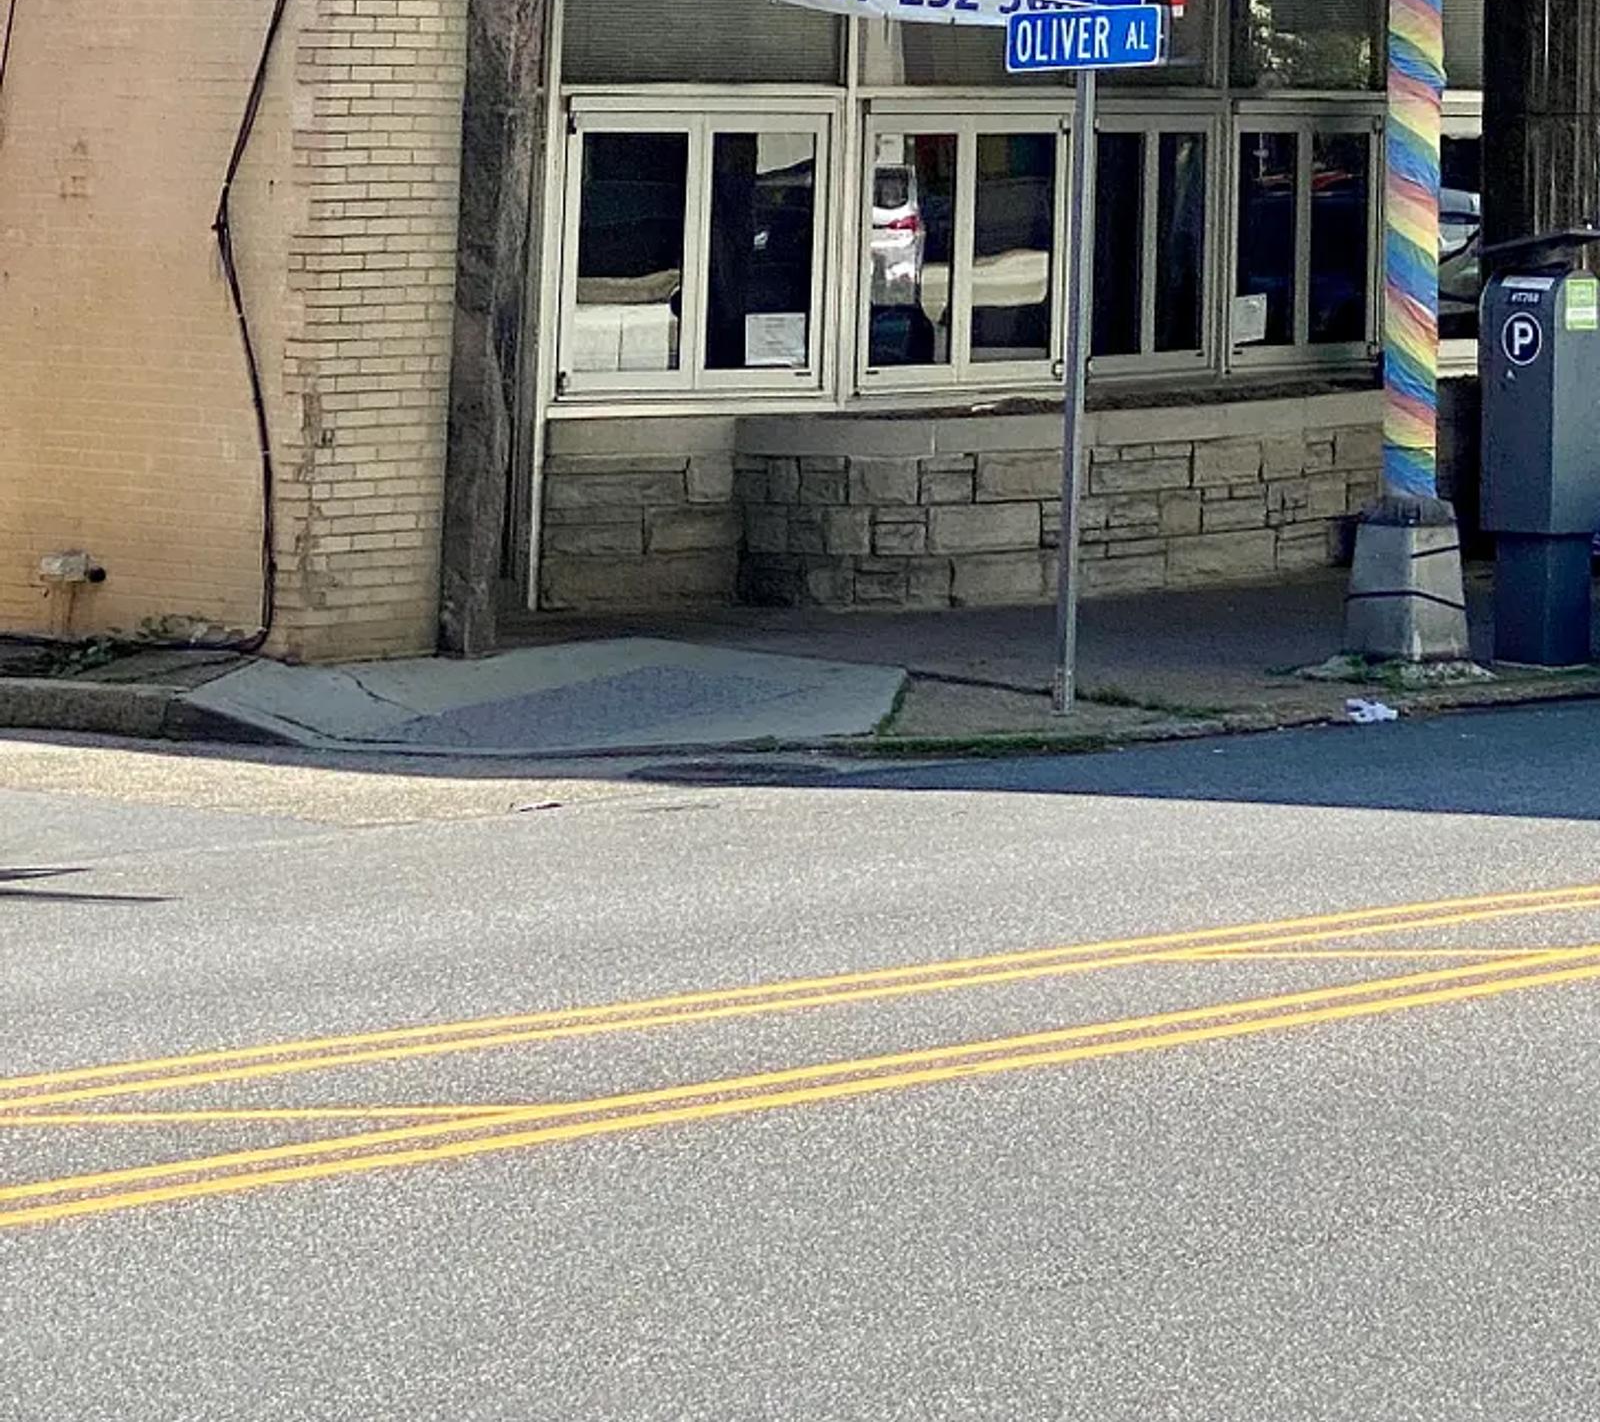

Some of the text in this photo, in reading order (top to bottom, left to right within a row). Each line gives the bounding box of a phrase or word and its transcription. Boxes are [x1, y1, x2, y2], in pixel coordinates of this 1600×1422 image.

[1015, 15, 1150, 63] OLIVER AL
[1513, 321, 1535, 356] P
